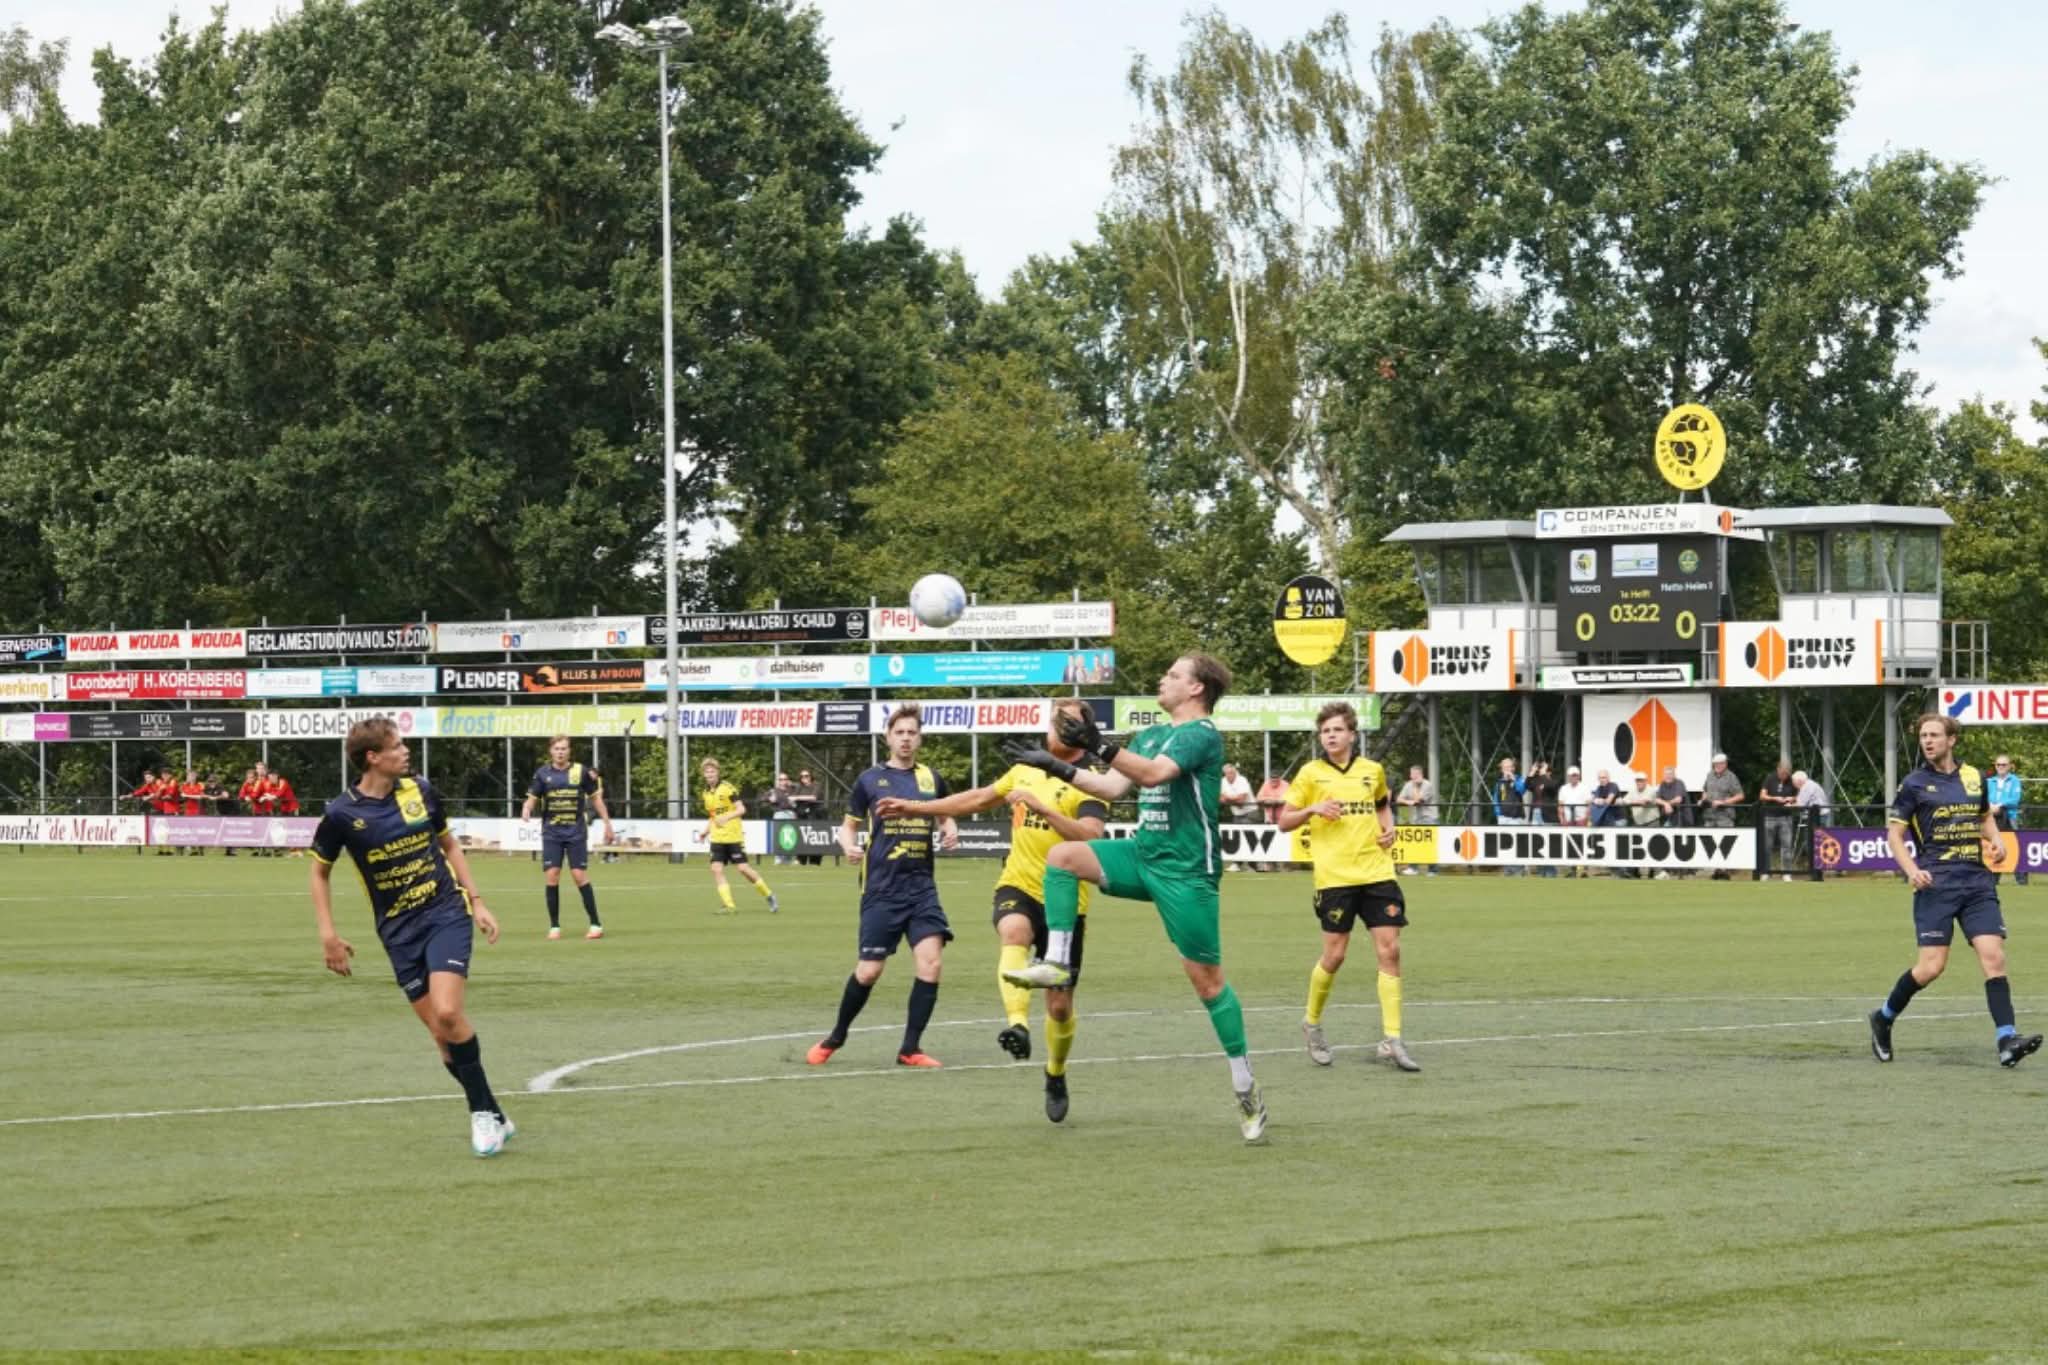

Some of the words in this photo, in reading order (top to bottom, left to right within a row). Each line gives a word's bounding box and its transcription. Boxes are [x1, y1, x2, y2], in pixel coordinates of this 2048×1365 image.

[1563, 507, 1677, 522] COMPANJEN
[1305, 588, 1335, 602] VAN
[1305, 603, 1335, 617] ZON
[1609, 604, 1660, 623] 03:22
[793, 612, 836, 629] SCHULD
[881, 609, 925, 633] Pleij
[1576, 612, 1596, 641] 0
[1675, 610, 1697, 639] 0
[69, 635, 119, 652] WOUDA
[129, 633, 180, 650] WOUDA
[191, 631, 242, 649] WOUDA
[1787, 638, 1856, 653] PRINS
[1431, 645, 1491, 660] PRINS
[1787, 654, 1853, 669] BOUW
[562, 669, 587, 680] KLUS
[600, 667, 642, 679] AFBOUW
[770, 659, 824, 674] dalhuisen
[1431, 661, 1489, 675] BOUW
[69, 673, 139, 693] Loonbedrijf
[443, 669, 519, 690] PLENDER
[1977, 689, 2048, 720] INTE
[250, 714, 270, 734] DE
[279, 711, 396, 735] BLOEME
[977, 704, 1041, 726] ELBURG
[800, 826, 830, 845] Van
[1221, 829, 1276, 855] UW
[1394, 829, 1433, 843] NSOR
[1484, 832, 1606, 859] PRINS
[1616, 833, 1739, 862] BOUW
